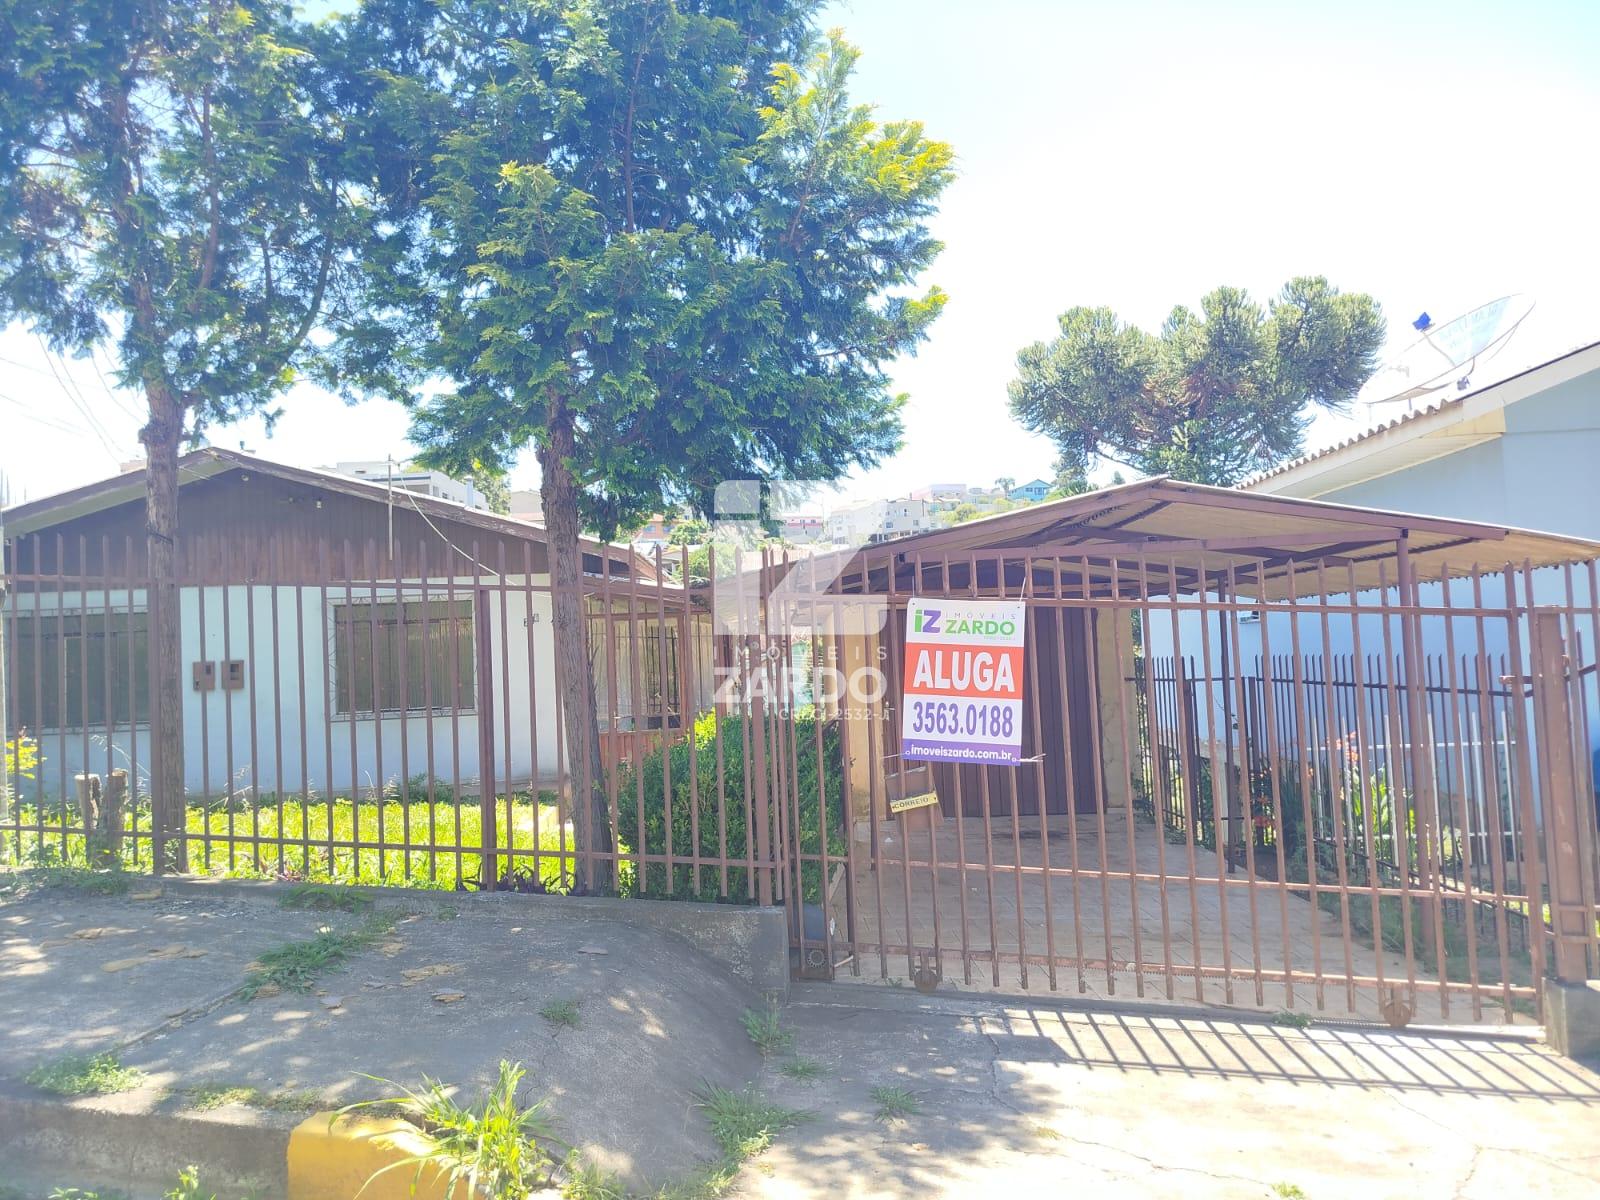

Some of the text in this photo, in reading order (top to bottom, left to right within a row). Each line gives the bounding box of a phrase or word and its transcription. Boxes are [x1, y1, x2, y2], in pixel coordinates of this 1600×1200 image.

[944, 619, 1016, 636] ZARDO
[912, 649, 1016, 693] ALUGA
[912, 701, 1013, 738] 3563.0188
[911, 744, 1012, 761] imoveiszardo.com.br
[894, 796, 929, 809] CORREIO
